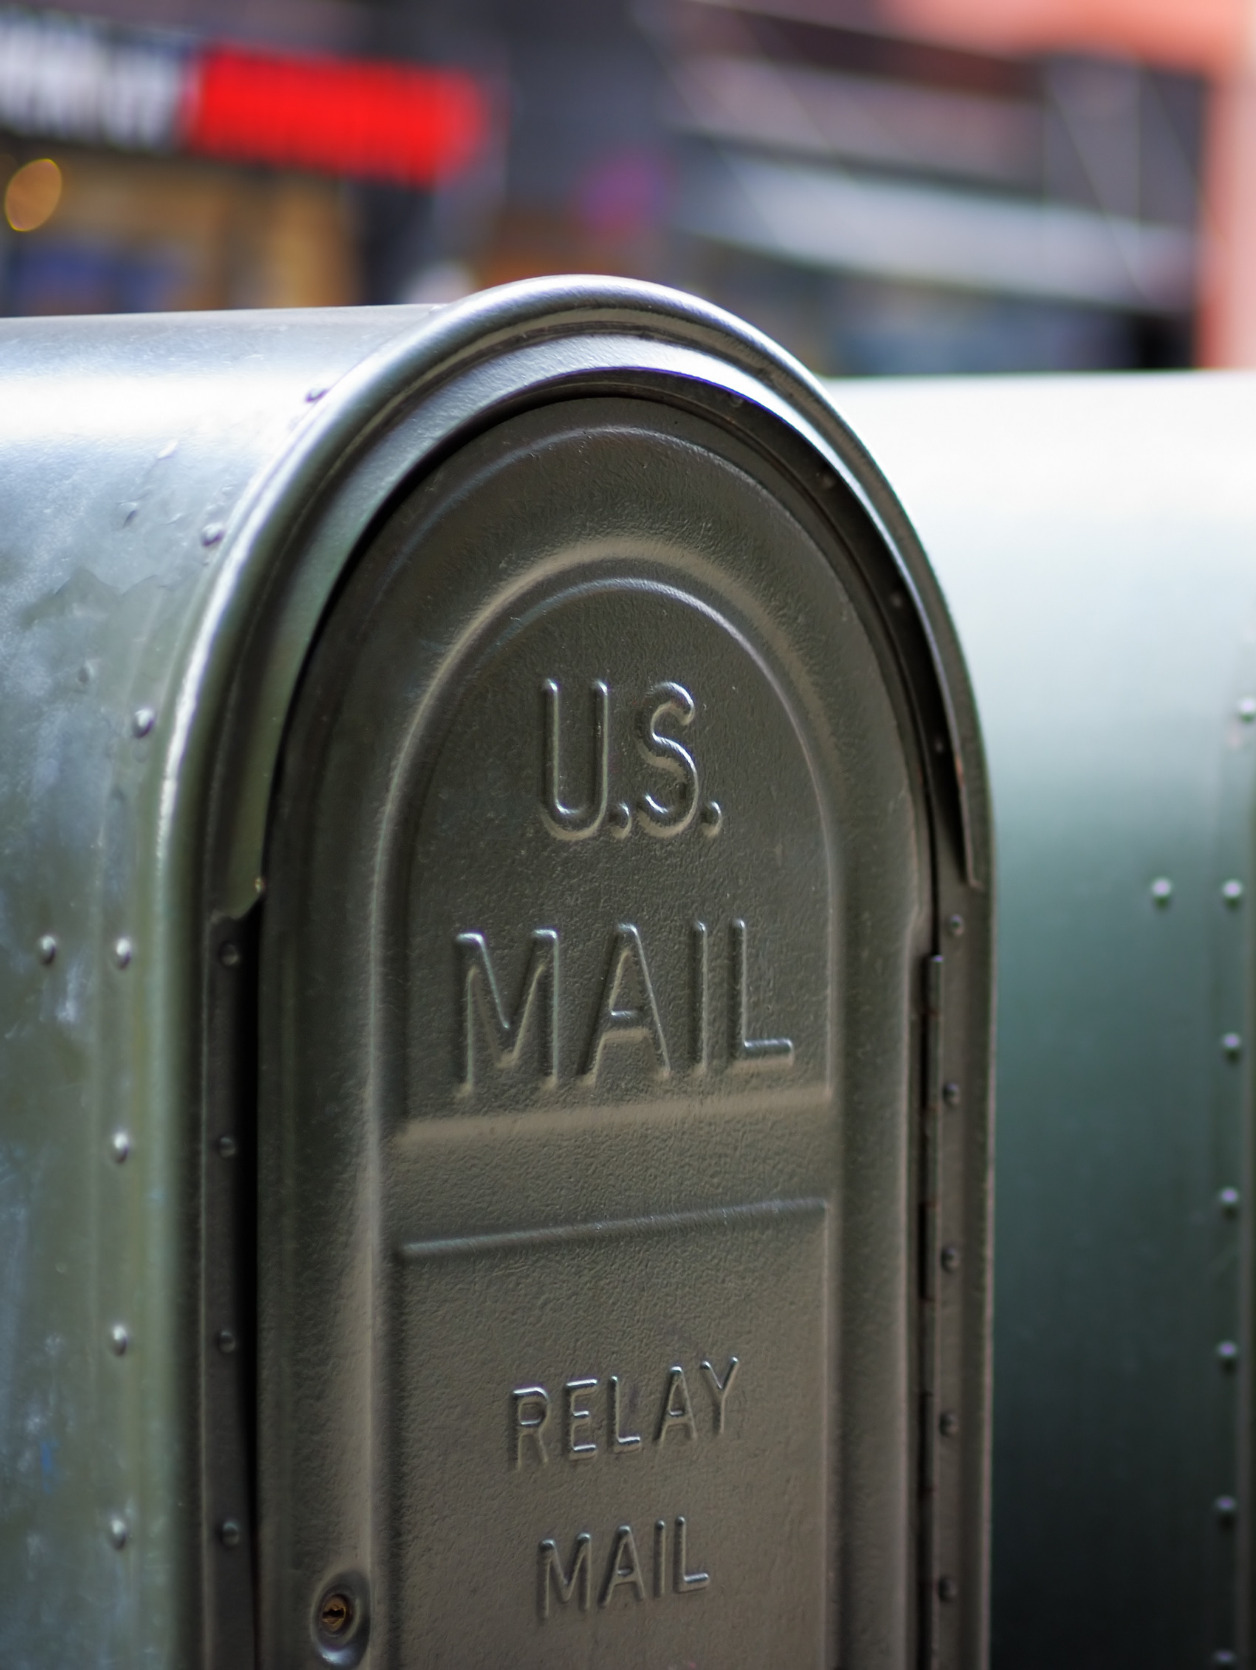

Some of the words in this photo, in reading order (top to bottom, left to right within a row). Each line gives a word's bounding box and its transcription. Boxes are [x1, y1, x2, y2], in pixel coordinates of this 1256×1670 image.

[538, 678, 722, 841] U.S.
[455, 918, 794, 1097] MAIL
[509, 1357, 739, 1472] RELAY
[536, 1516, 710, 1622] MAIL
